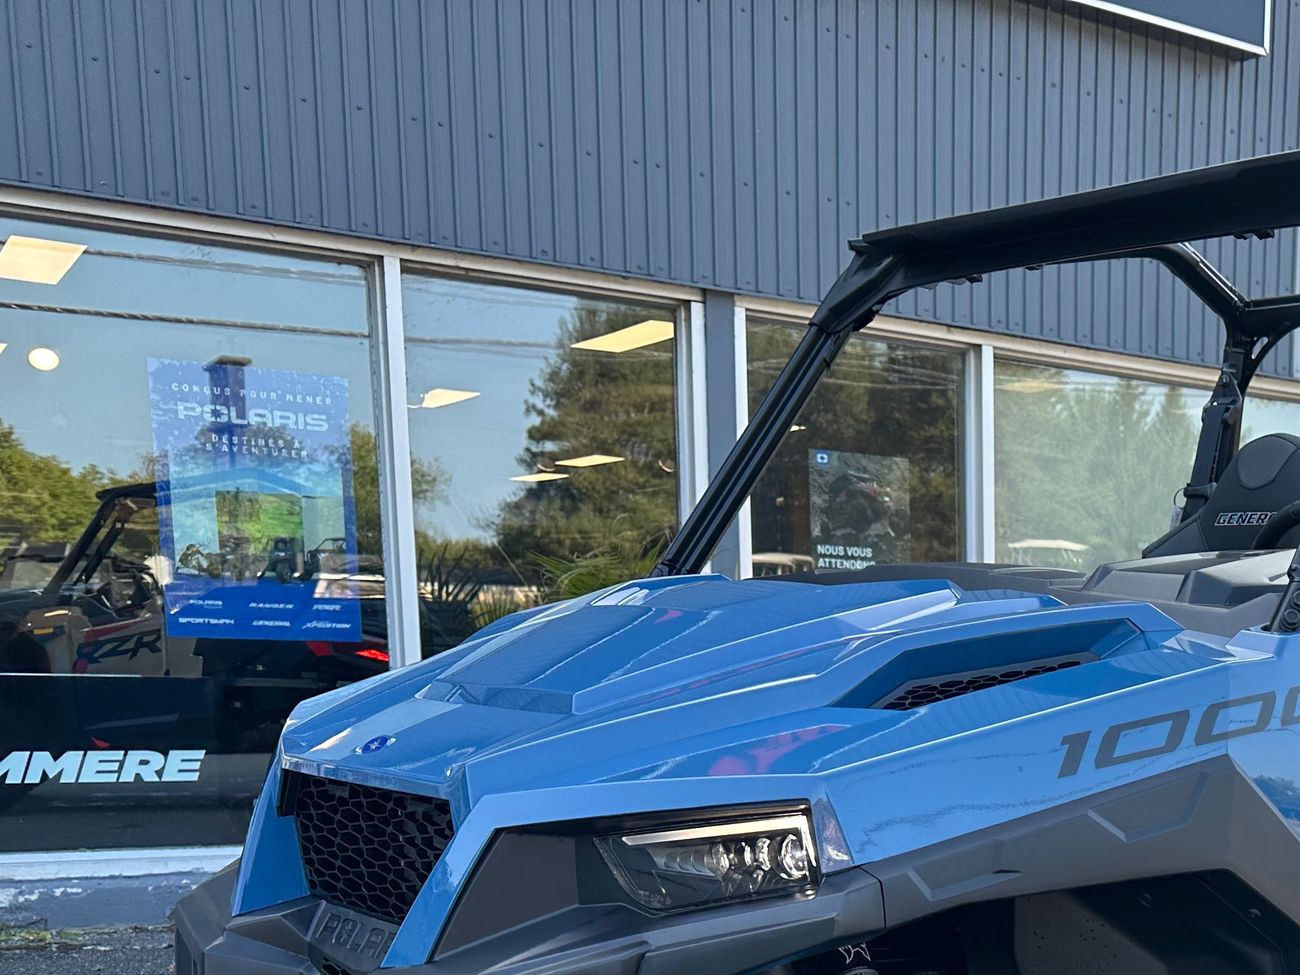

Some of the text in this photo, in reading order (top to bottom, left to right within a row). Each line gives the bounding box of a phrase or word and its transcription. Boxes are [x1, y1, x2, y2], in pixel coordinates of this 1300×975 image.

[240, 389, 277, 400] POUR
[286, 393, 332, 405] MENER
[177, 401, 329, 431] POLARIS
[817, 545, 872, 557] NOUS VOUS
[316, 912, 398, 959] POLA
